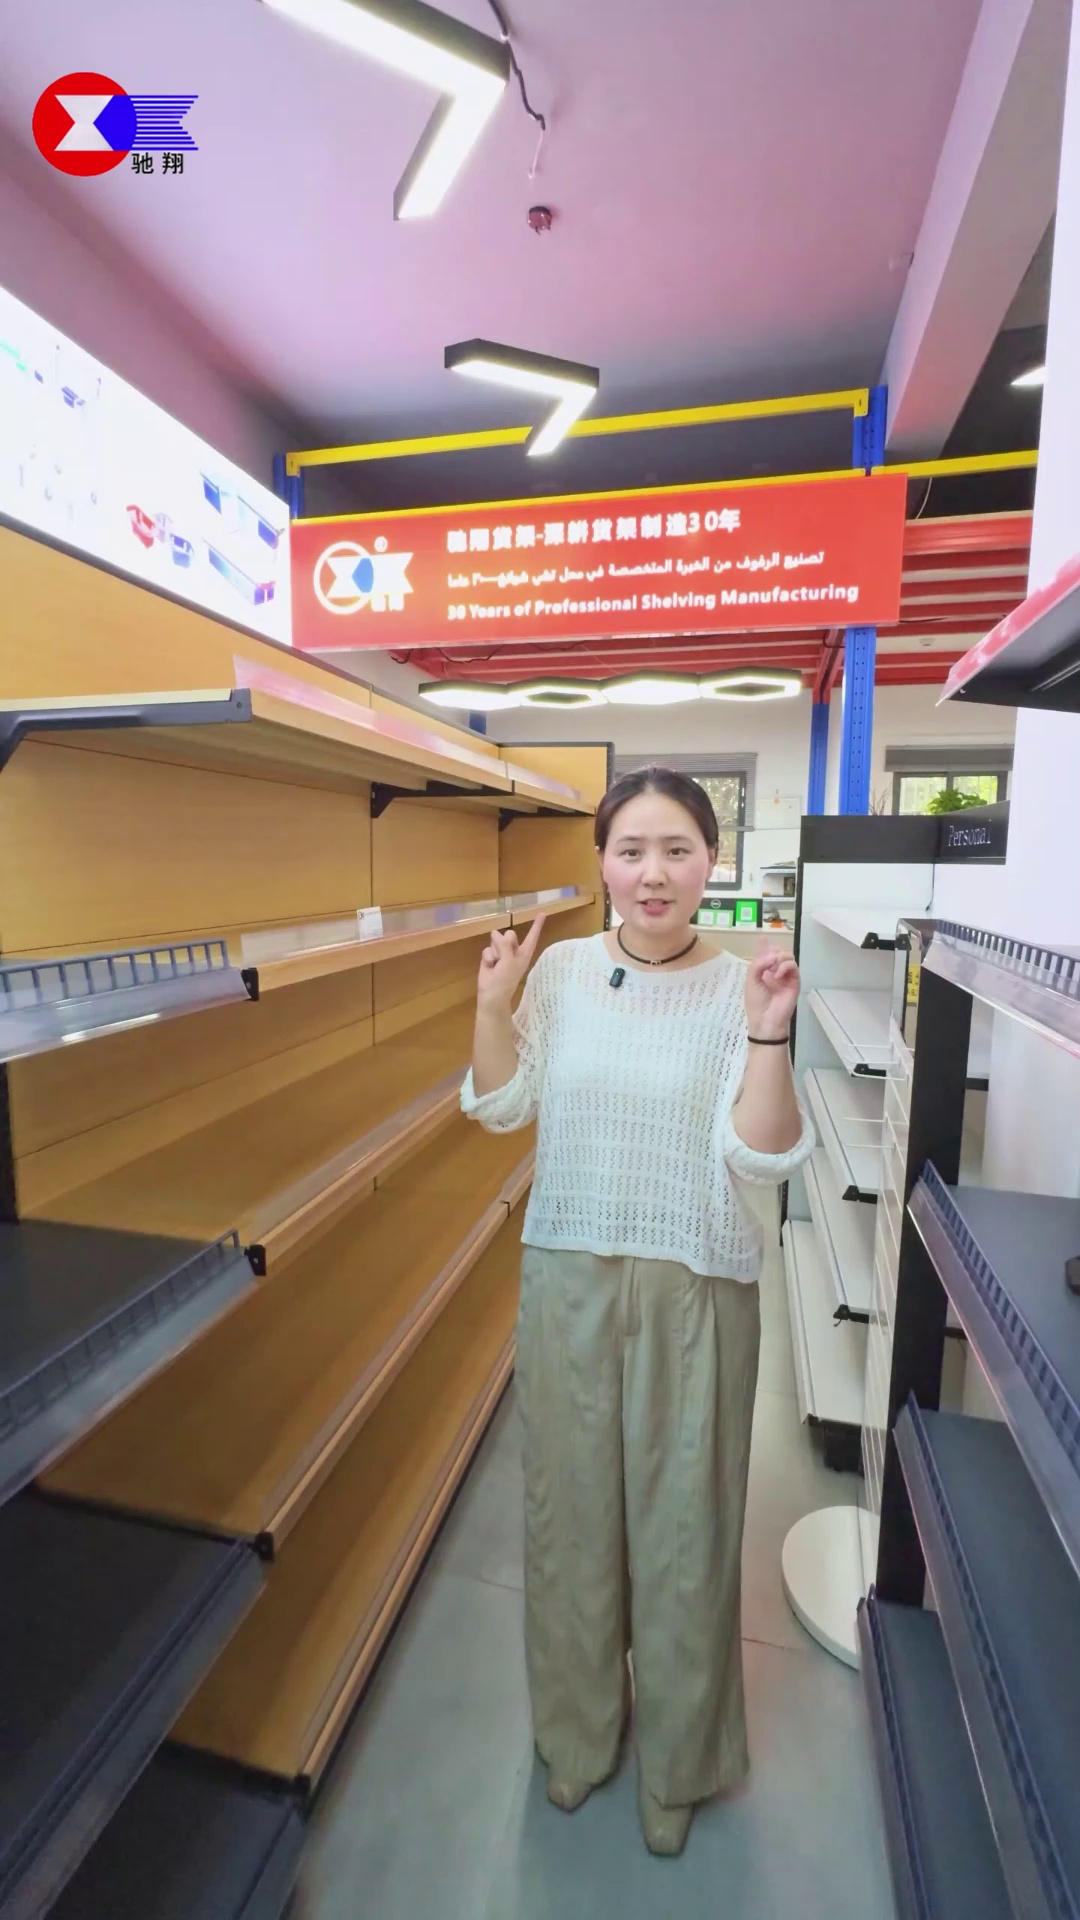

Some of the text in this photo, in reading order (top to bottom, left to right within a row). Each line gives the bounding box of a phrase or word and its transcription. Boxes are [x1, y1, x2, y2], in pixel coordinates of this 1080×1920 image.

[676, 556, 710, 576] الخبرة
[713, 561, 732, 573] من
[736, 551, 780, 572] الرفوف
[585, 565, 604, 582] في
[469, 604, 511, 620] Years
[513, 600, 532, 617] of
[534, 594, 637, 616] Professional
[641, 591, 716, 611] Shelving
[720, 582, 859, 606] Manufacturing
[947, 818, 993, 847] Personal
